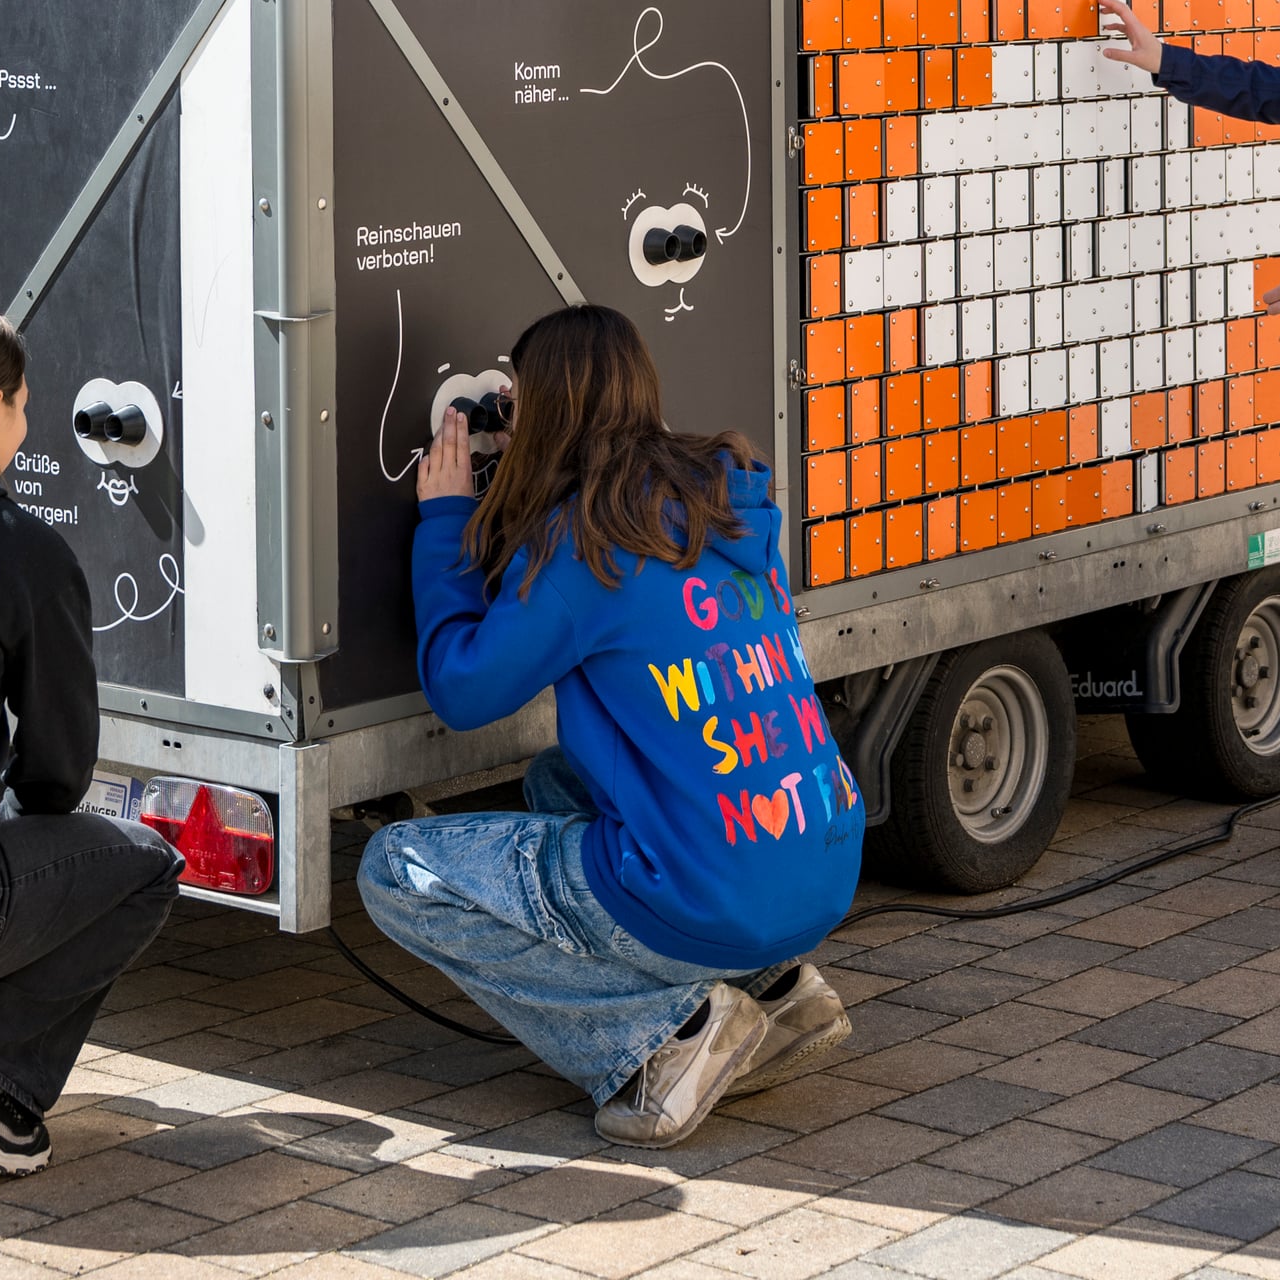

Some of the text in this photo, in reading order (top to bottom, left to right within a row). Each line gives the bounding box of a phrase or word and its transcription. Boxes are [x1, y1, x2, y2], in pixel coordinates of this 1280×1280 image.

[514, 62, 561, 81] Komm
[356, 220, 462, 247] Reinschauen
[356, 243, 435, 271] verboten!
[15, 451, 60, 475] Grüße
[14, 479, 43, 497] von
[683, 570, 764, 631] GOD
[648, 633, 793, 722] WITHIN
[702, 710, 789, 775] SHE
